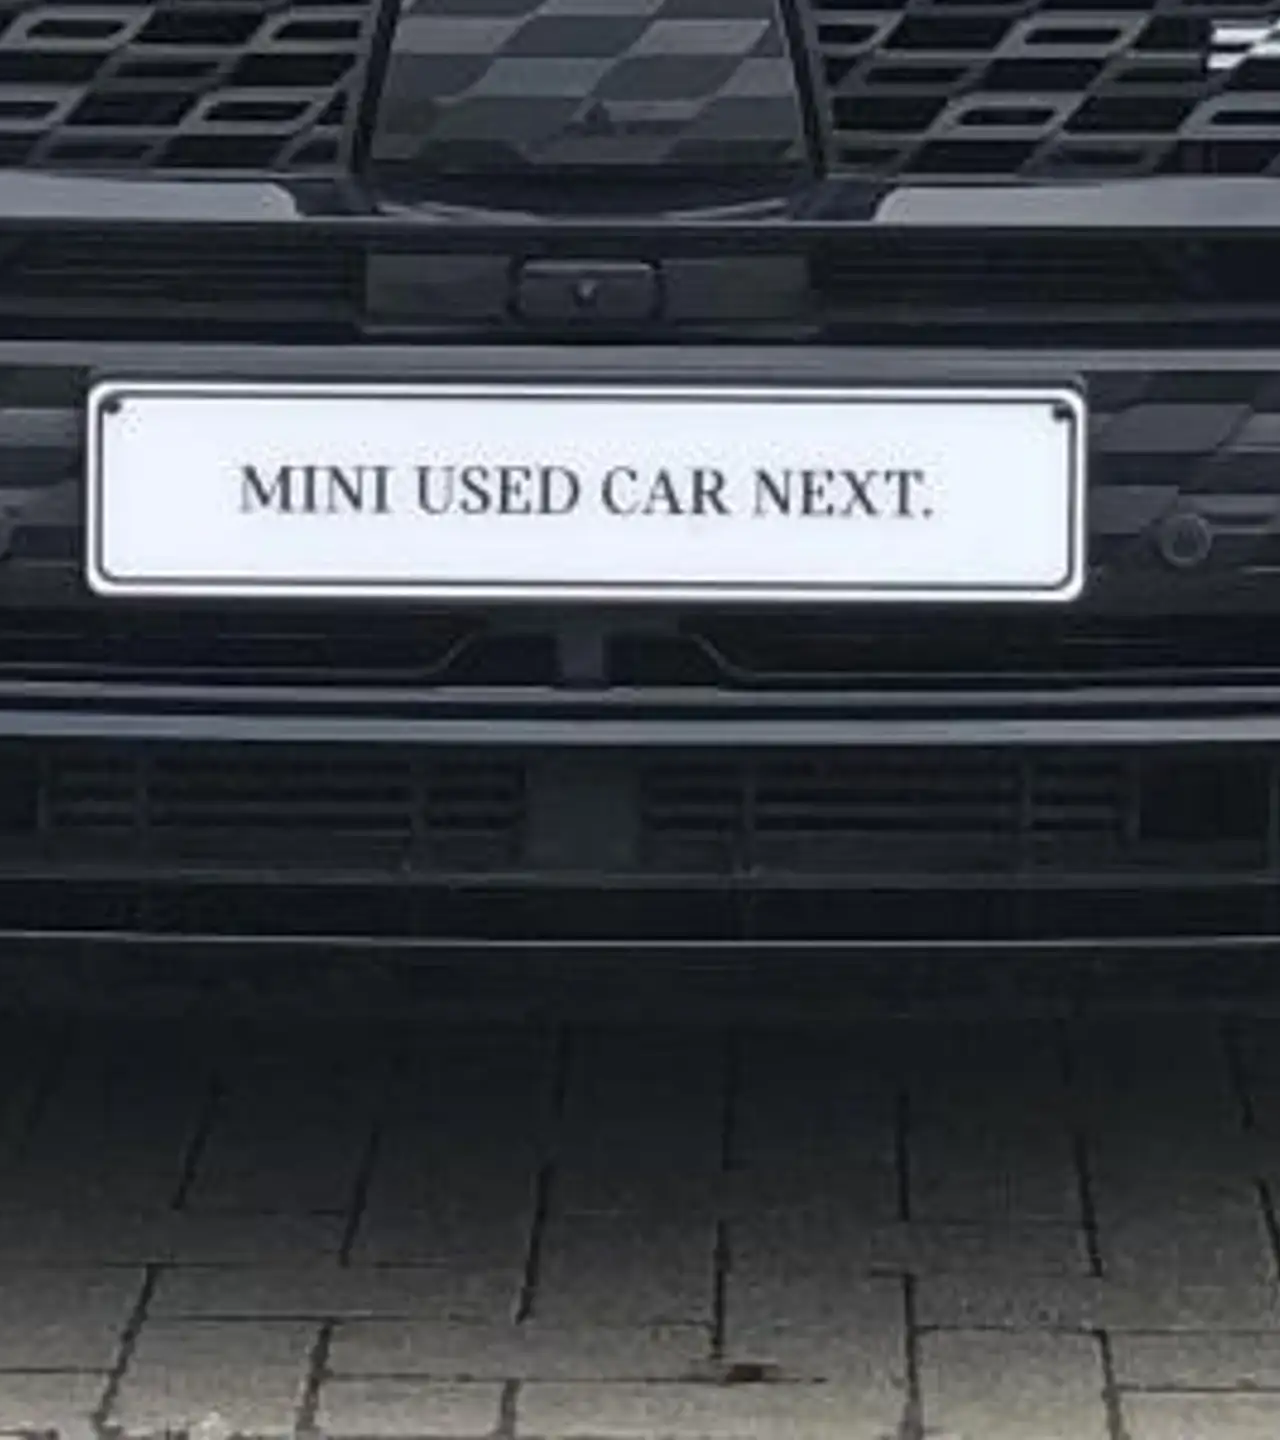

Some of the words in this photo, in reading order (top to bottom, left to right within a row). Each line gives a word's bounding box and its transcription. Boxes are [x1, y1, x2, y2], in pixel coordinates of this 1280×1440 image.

[240, 464, 391, 515] MINI
[415, 464, 582, 516] USED
[600, 465, 730, 516] CAR
[753, 467, 933, 518] NEXT.
